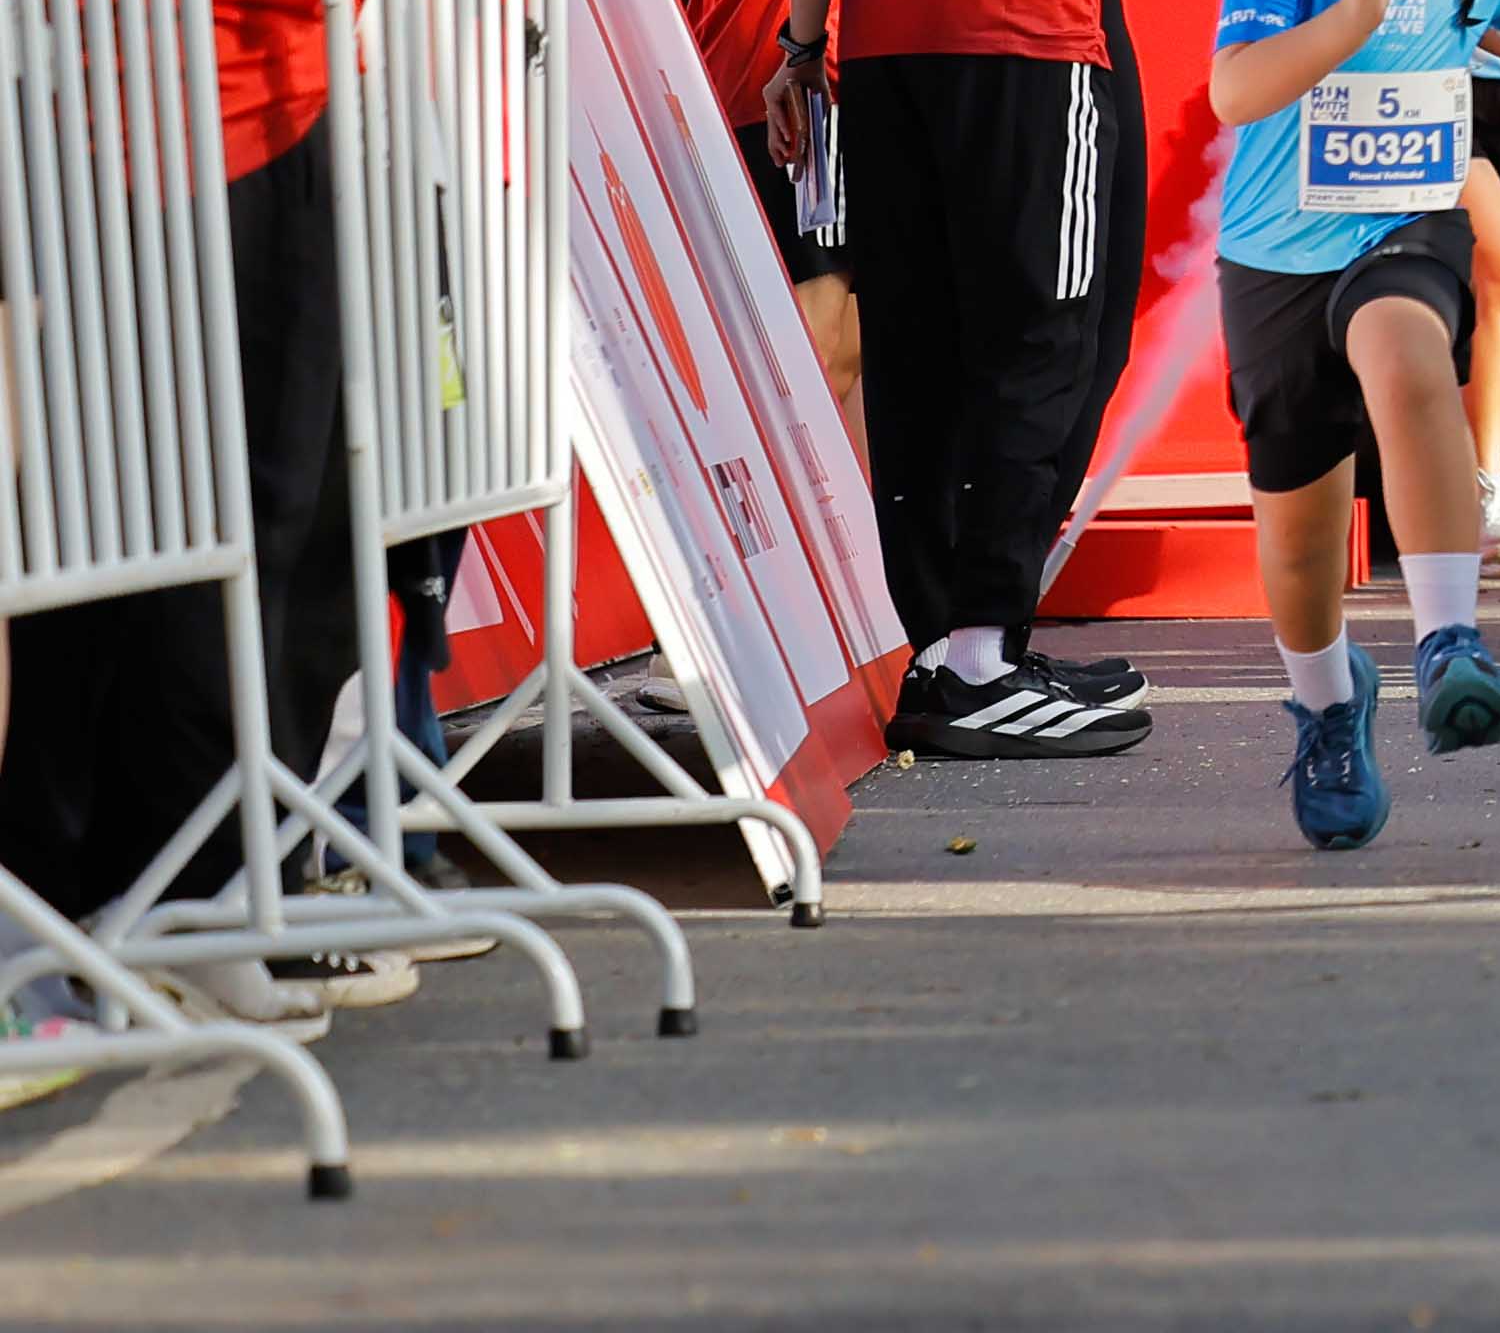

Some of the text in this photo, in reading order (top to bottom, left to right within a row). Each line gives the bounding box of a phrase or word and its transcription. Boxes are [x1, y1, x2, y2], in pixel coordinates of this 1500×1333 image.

[1311, 87, 1349, 100] RUN
[1377, 87, 1400, 118] 5
[1311, 100, 1349, 111] WITH
[1324, 129, 1442, 166] 50321
